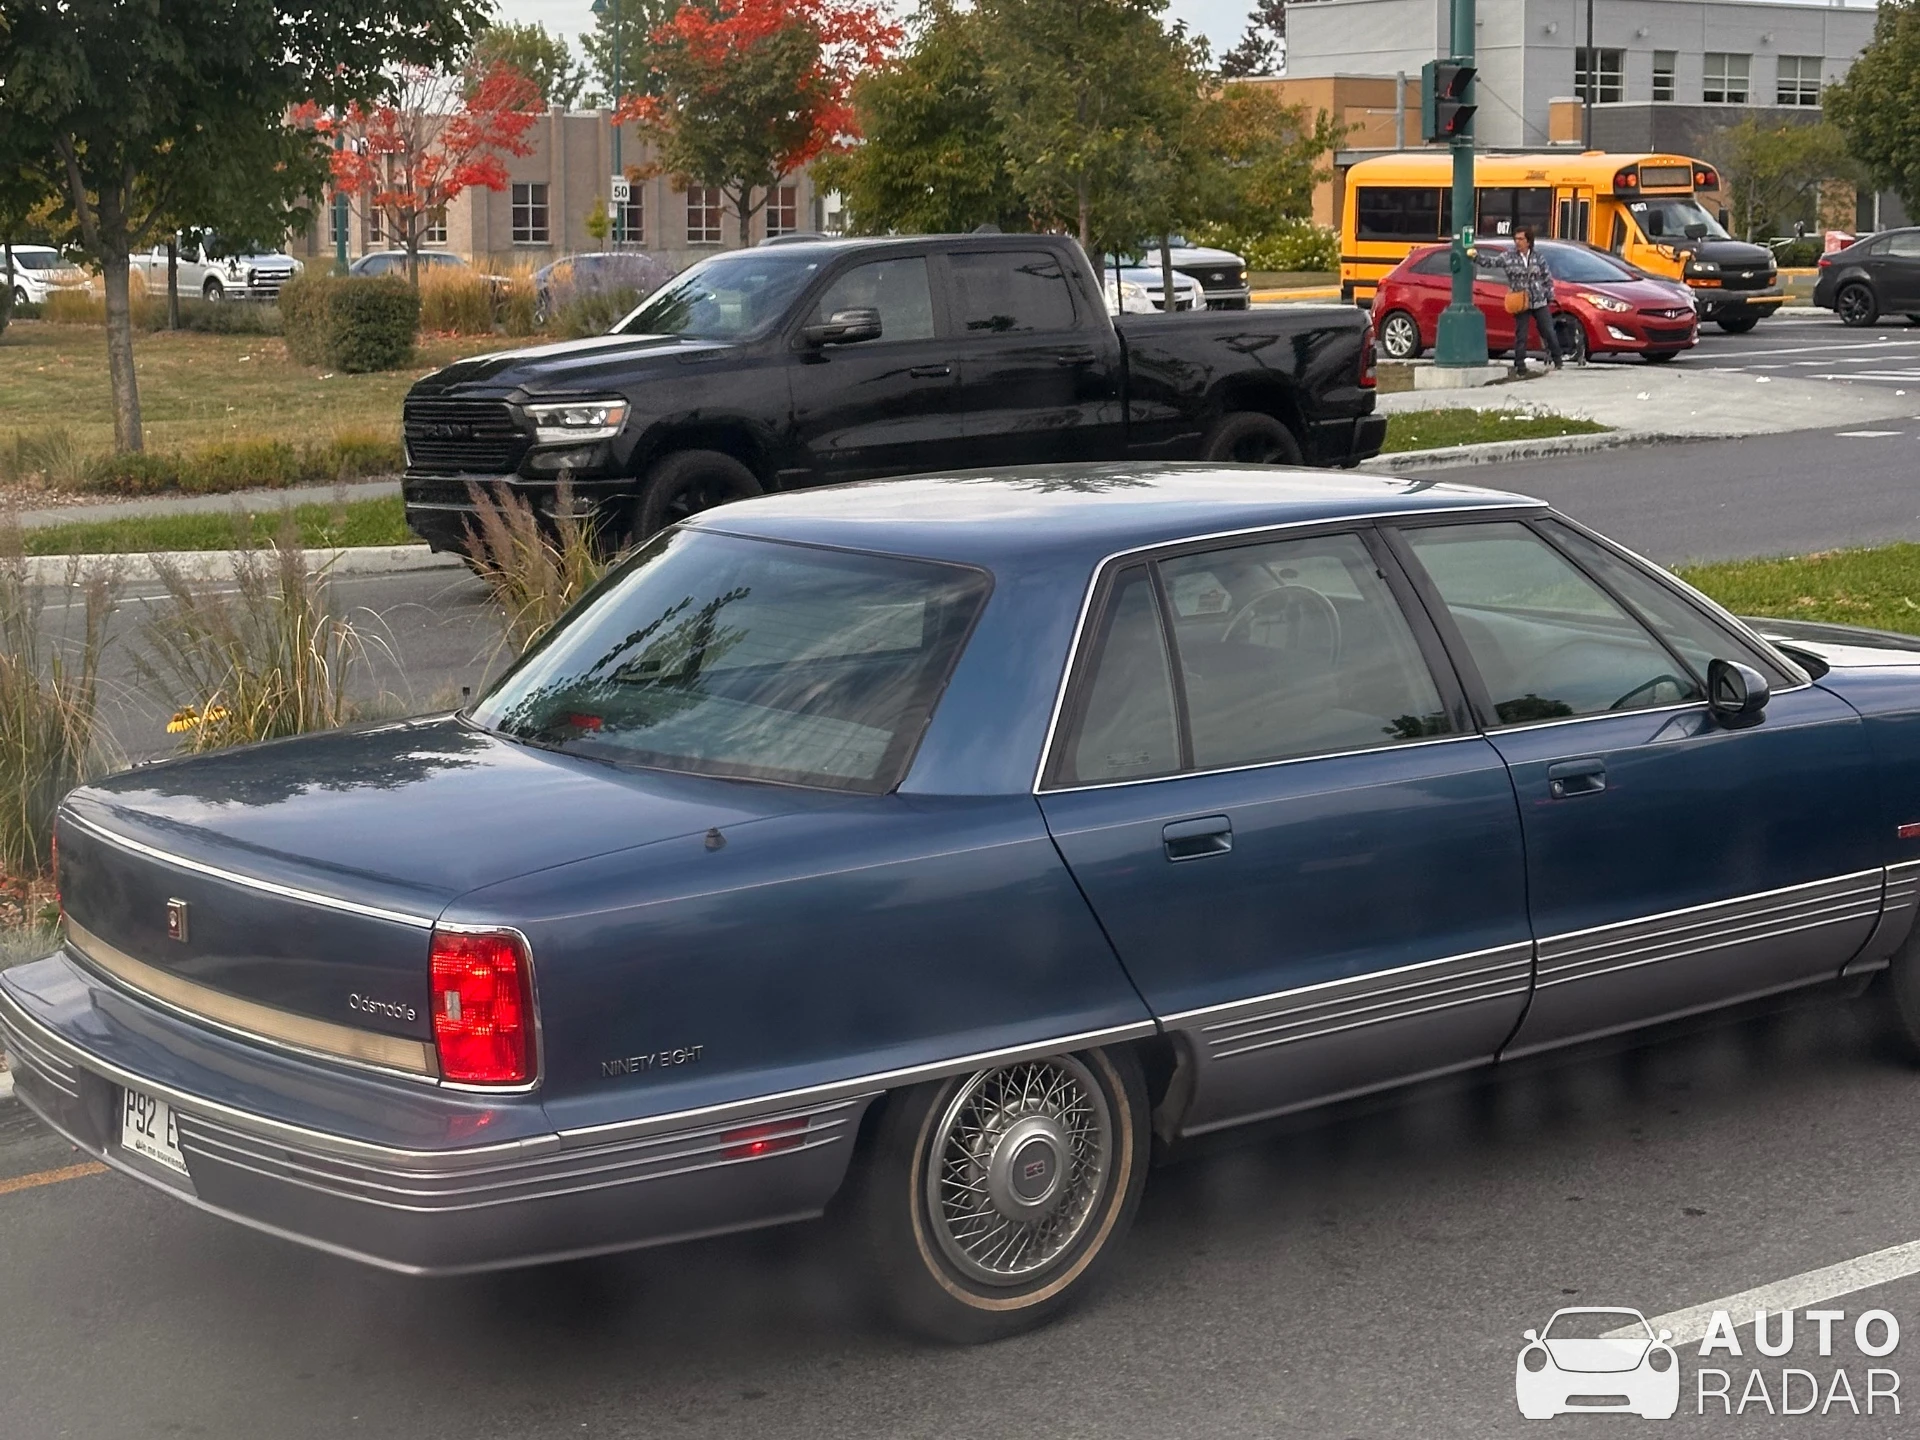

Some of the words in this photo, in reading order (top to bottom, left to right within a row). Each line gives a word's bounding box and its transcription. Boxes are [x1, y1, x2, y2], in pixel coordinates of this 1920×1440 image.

[614, 186, 628, 198] 50
[349, 993, 416, 1021] Oldsmobile
[601, 1054, 655, 1077] NINETY
[660, 1045, 704, 1067] EIGHT
[125, 1089, 156, 1139] P92
